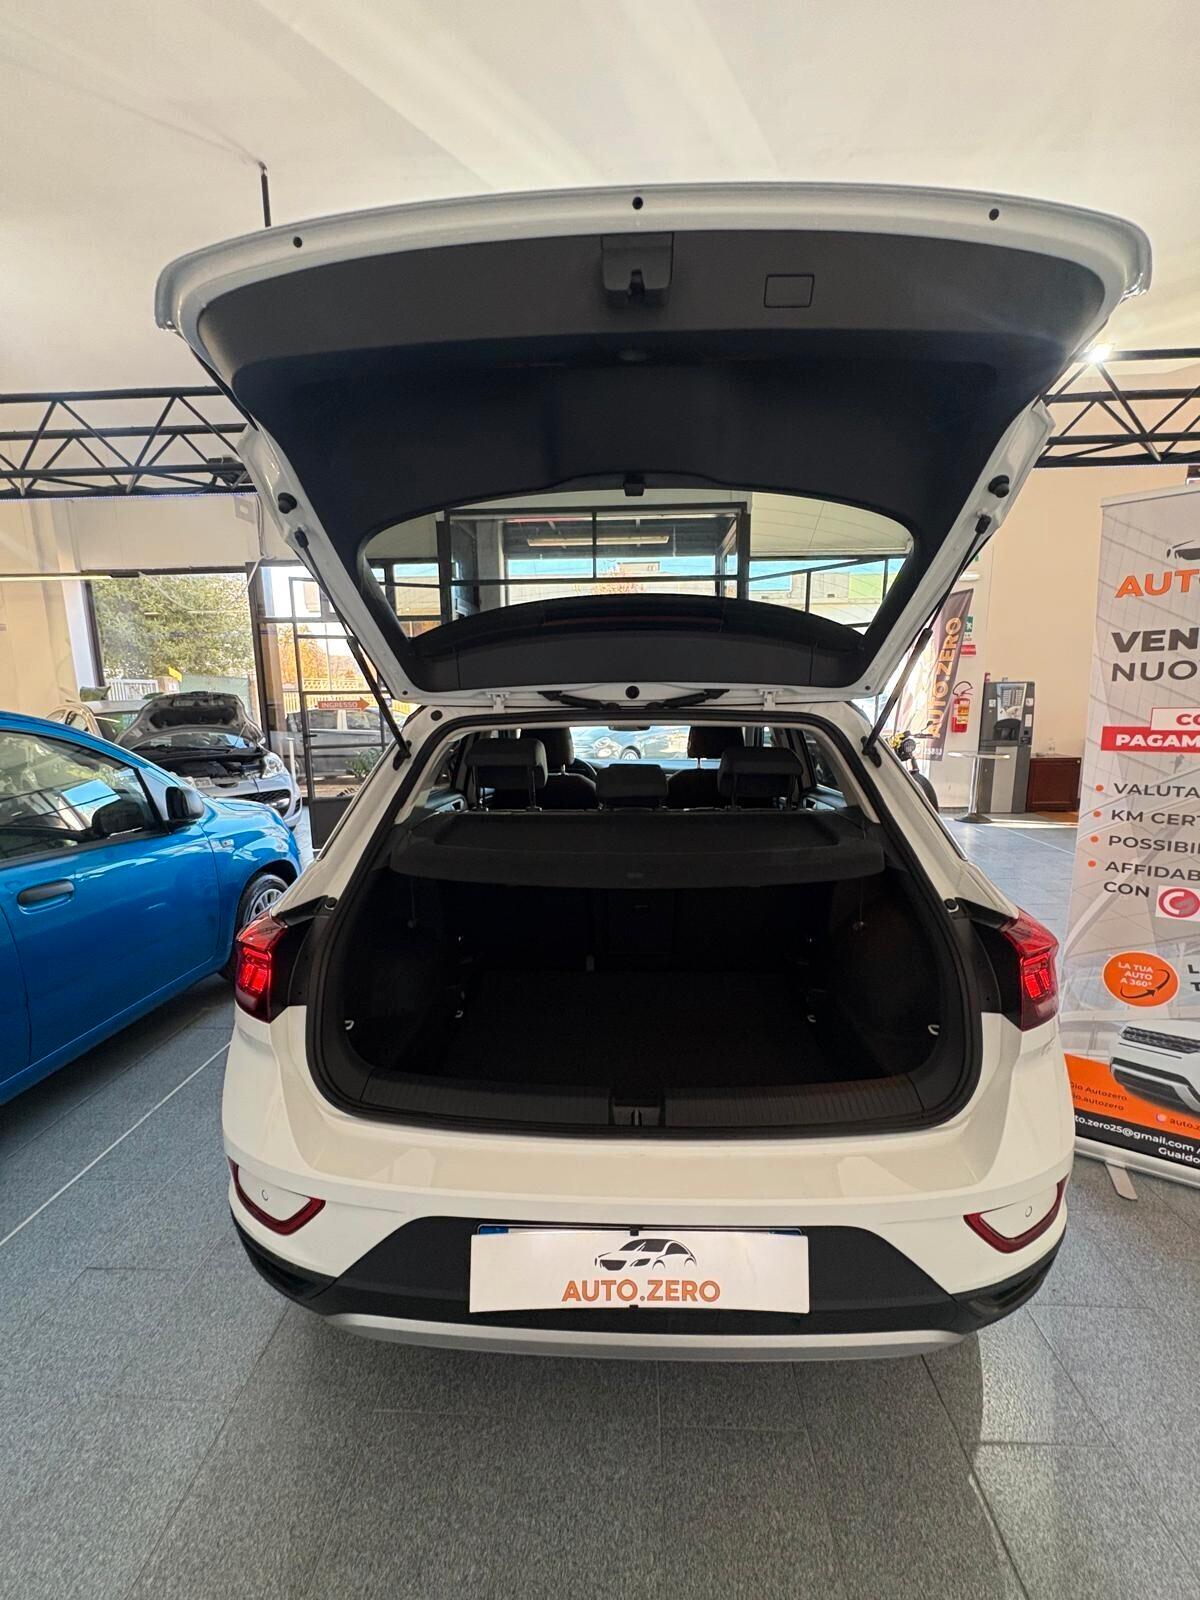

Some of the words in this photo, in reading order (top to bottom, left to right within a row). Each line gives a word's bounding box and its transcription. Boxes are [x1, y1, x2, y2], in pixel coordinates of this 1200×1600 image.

[1115, 569, 1200, 598] AUT
[1111, 627, 1199, 653] VEN
[927, 617, 962, 738] AUTO.ZERO
[1111, 660, 1200, 682] NUO
[321, 701, 358, 709] INGRESSO
[1115, 734, 1200, 748] PAGAM
[1113, 783, 1200, 798] VALUTA
[1111, 809, 1144, 822] KM
[1151, 812, 1200, 827] CER
[1108, 835, 1200, 855] POSSIBI
[1105, 861, 1200, 882] AFFIDAB
[1103, 881, 1150, 898] CON
[1118, 961, 1131, 970] LA
[1133, 964, 1154, 973] TUA
[1124, 970, 1153, 981] AUTO
[1085, 1086, 1127, 1101] Autozero
[561, 1278, 721, 1303] AUTO.ZERO
